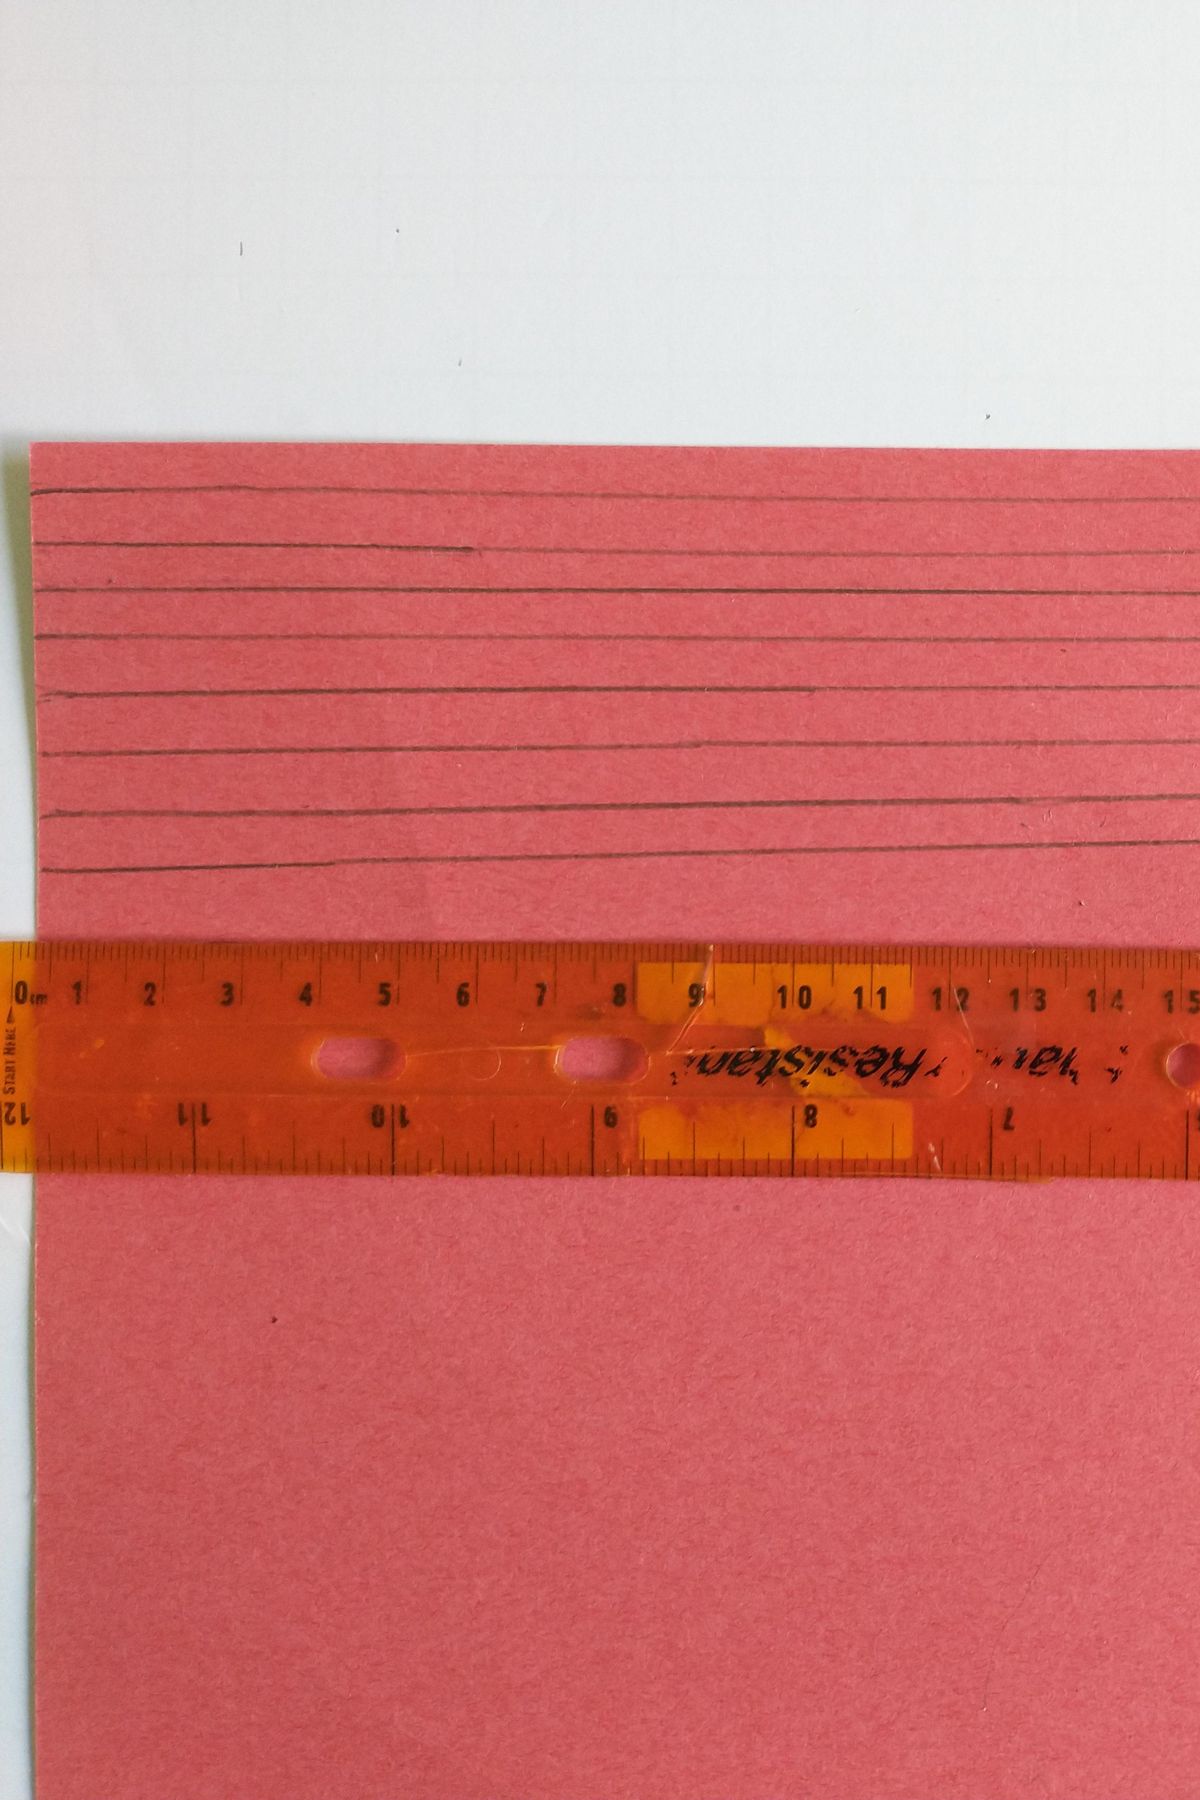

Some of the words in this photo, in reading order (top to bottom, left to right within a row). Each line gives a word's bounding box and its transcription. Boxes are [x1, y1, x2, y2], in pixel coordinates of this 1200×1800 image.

[14, 980, 29, 1005] 0
[72, 981, 82, 1005] 1
[144, 982, 156, 1005] 2
[221, 982, 234, 1006] 3
[299, 982, 312, 1006] 4
[378, 982, 391, 1006] 5
[456, 982, 470, 1007] 6
[535, 982, 547, 1007] 7
[612, 983, 627, 1007] 8
[688, 983, 705, 1008] 9
[777, 985, 812, 1010] 10
[853, 986, 887, 1010] 11
[932, 987, 970, 1012] 12
[1009, 988, 1047, 1011] 13
[1088, 988, 1124, 1012] 14
[1165, 990, 1200, 1013] 15
[3, 1102, 31, 1126] 12
[177, 1103, 212, 1127] 11
[371, 1104, 410, 1128] 10
[603, 1105, 618, 1128] 9
[804, 1104, 818, 1128] 8
[1003, 1107, 1015, 1131] 7
